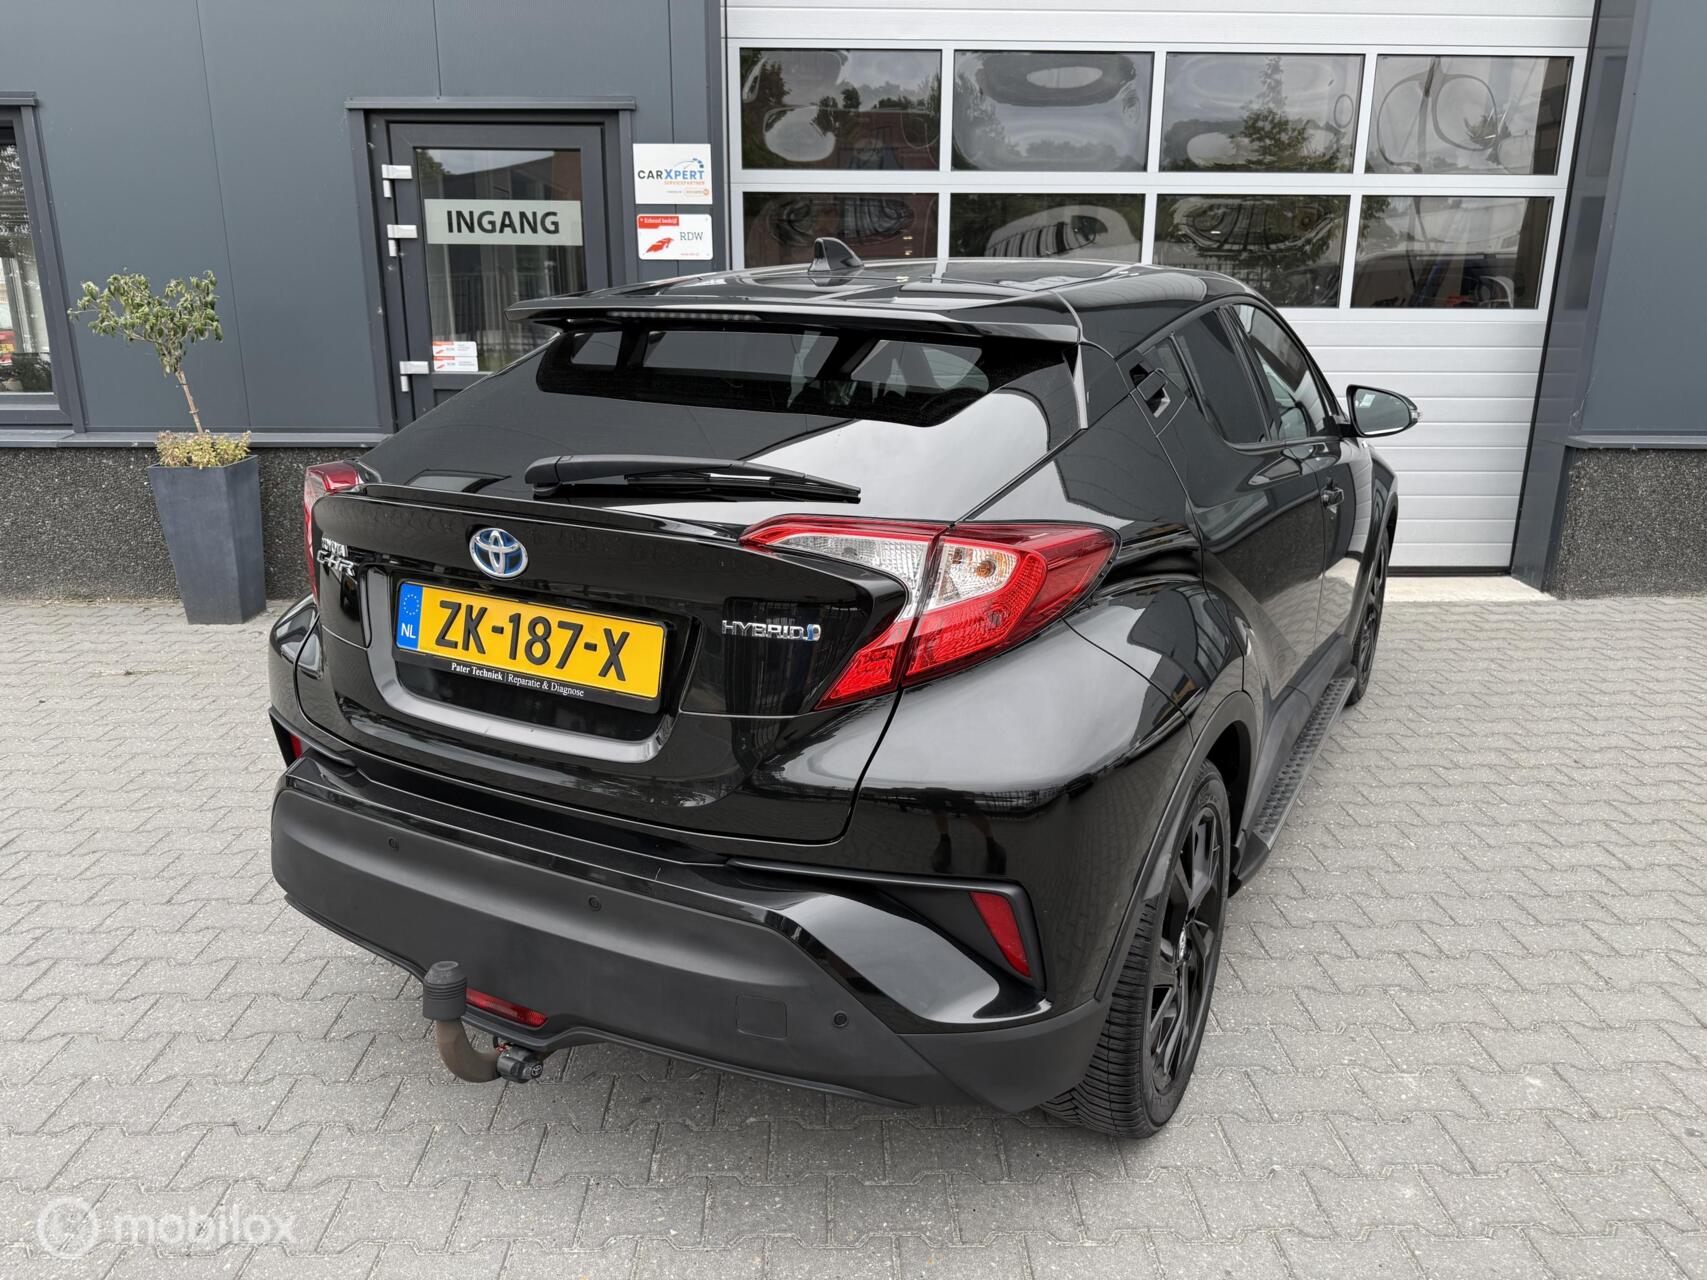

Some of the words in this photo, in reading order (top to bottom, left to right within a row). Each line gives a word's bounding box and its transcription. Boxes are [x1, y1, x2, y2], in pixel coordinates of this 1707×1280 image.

[637, 168, 705, 180] CARXPERT
[446, 210, 560, 235] INGANG
[679, 231, 704, 241] RDW
[401, 623, 417, 639] NL
[721, 619, 805, 640] HYBRID
[434, 600, 631, 682] ZK-187-X
[451, 662, 471, 674] Pater
[471, 665, 504, 681] Techniek
[508, 673, 541, 688] Reparatie
[541, 680, 550, 690] &
[550, 682, 585, 697] Diagnose
